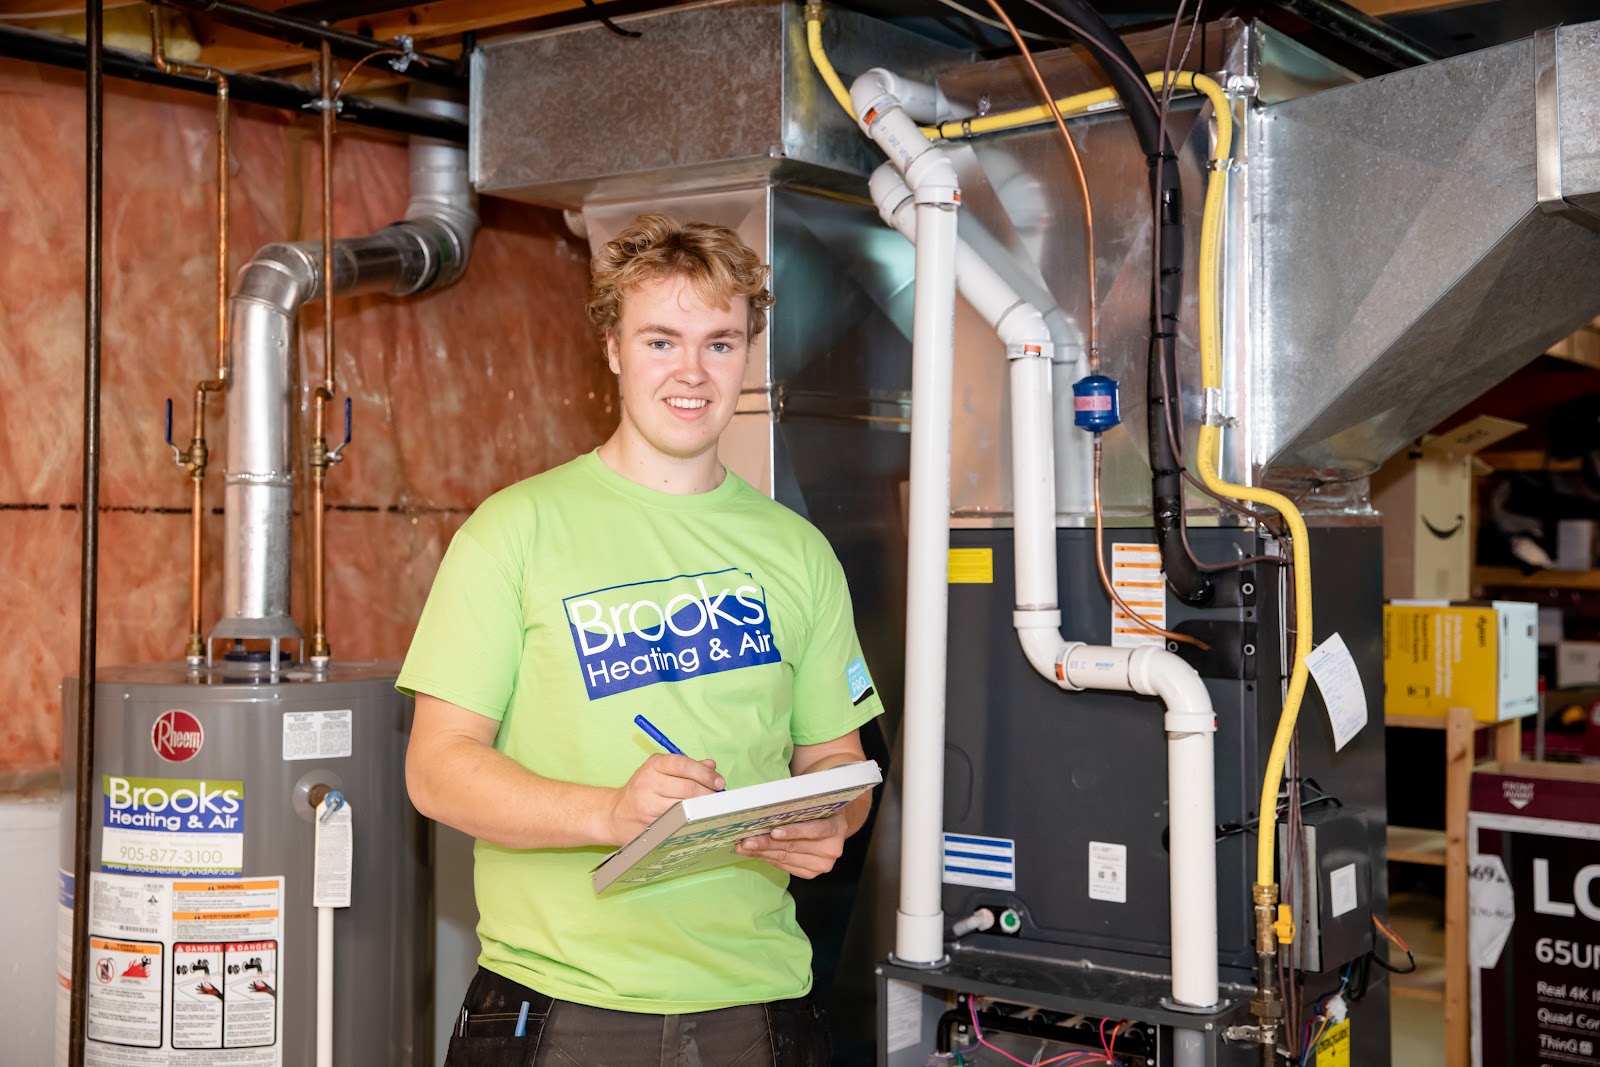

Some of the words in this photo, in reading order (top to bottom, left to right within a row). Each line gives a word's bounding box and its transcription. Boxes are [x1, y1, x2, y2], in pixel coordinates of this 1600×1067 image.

[569, 578, 766, 656] Brooks
[586, 646, 700, 688] Heating
[708, 637, 731, 662] &
[739, 630, 771, 657] Air
[157, 711, 200, 755] Rheem
[109, 777, 240, 814] Brooks
[109, 810, 181, 831] Heating
[187, 815, 204, 829] &
[208, 815, 238, 829] Air
[120, 846, 222, 864] 905-877-3100
[106, 863, 235, 876] www.BrooksHeatingAndAir.ca
[237, 943, 274, 951] DANGER
[1536, 980, 1567, 998] Real
[1569, 985, 1590, 1002] 4K
[1537, 1007, 1574, 1027] Quad
[1538, 1033, 1578, 1053] ThinQ
